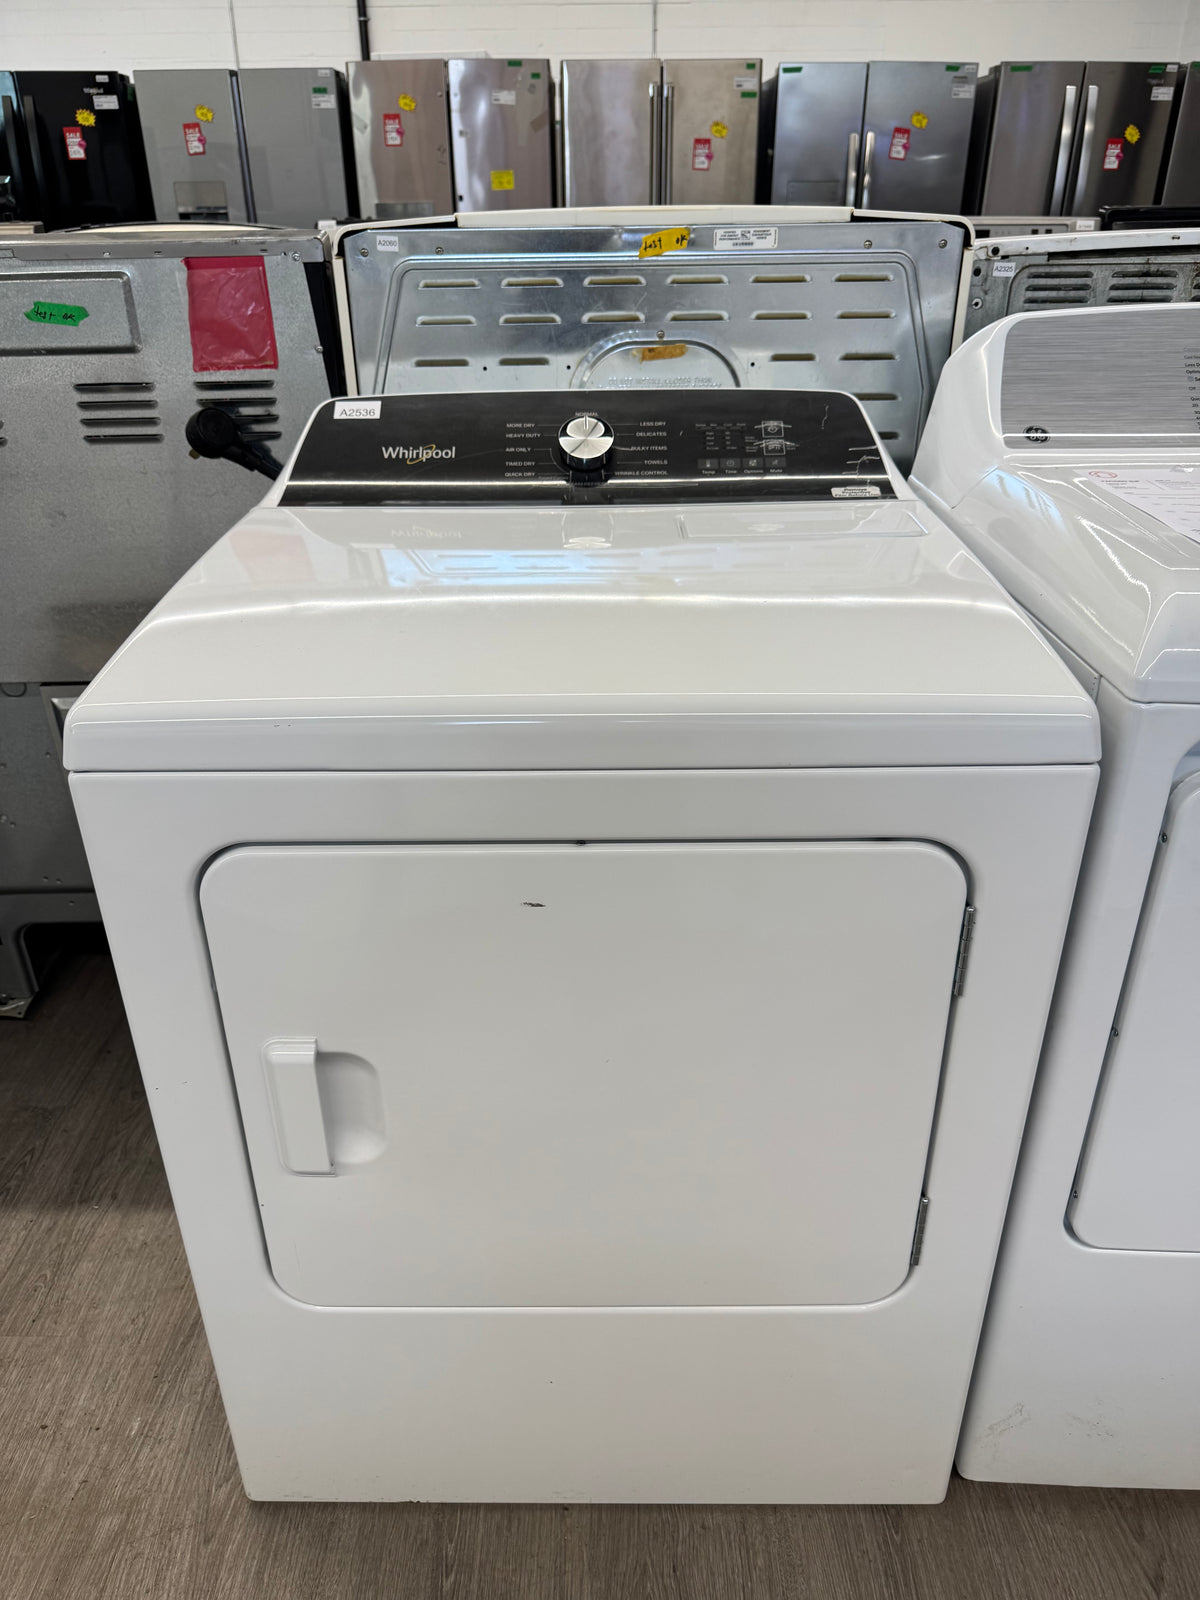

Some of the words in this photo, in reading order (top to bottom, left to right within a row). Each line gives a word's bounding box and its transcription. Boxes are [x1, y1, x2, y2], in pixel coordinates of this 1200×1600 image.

[377, 239, 398, 247] A2060
[994, 265, 1014, 273] A2325
[339, 408, 376, 417] A2536
[382, 445, 456, 463] Whirlpool
